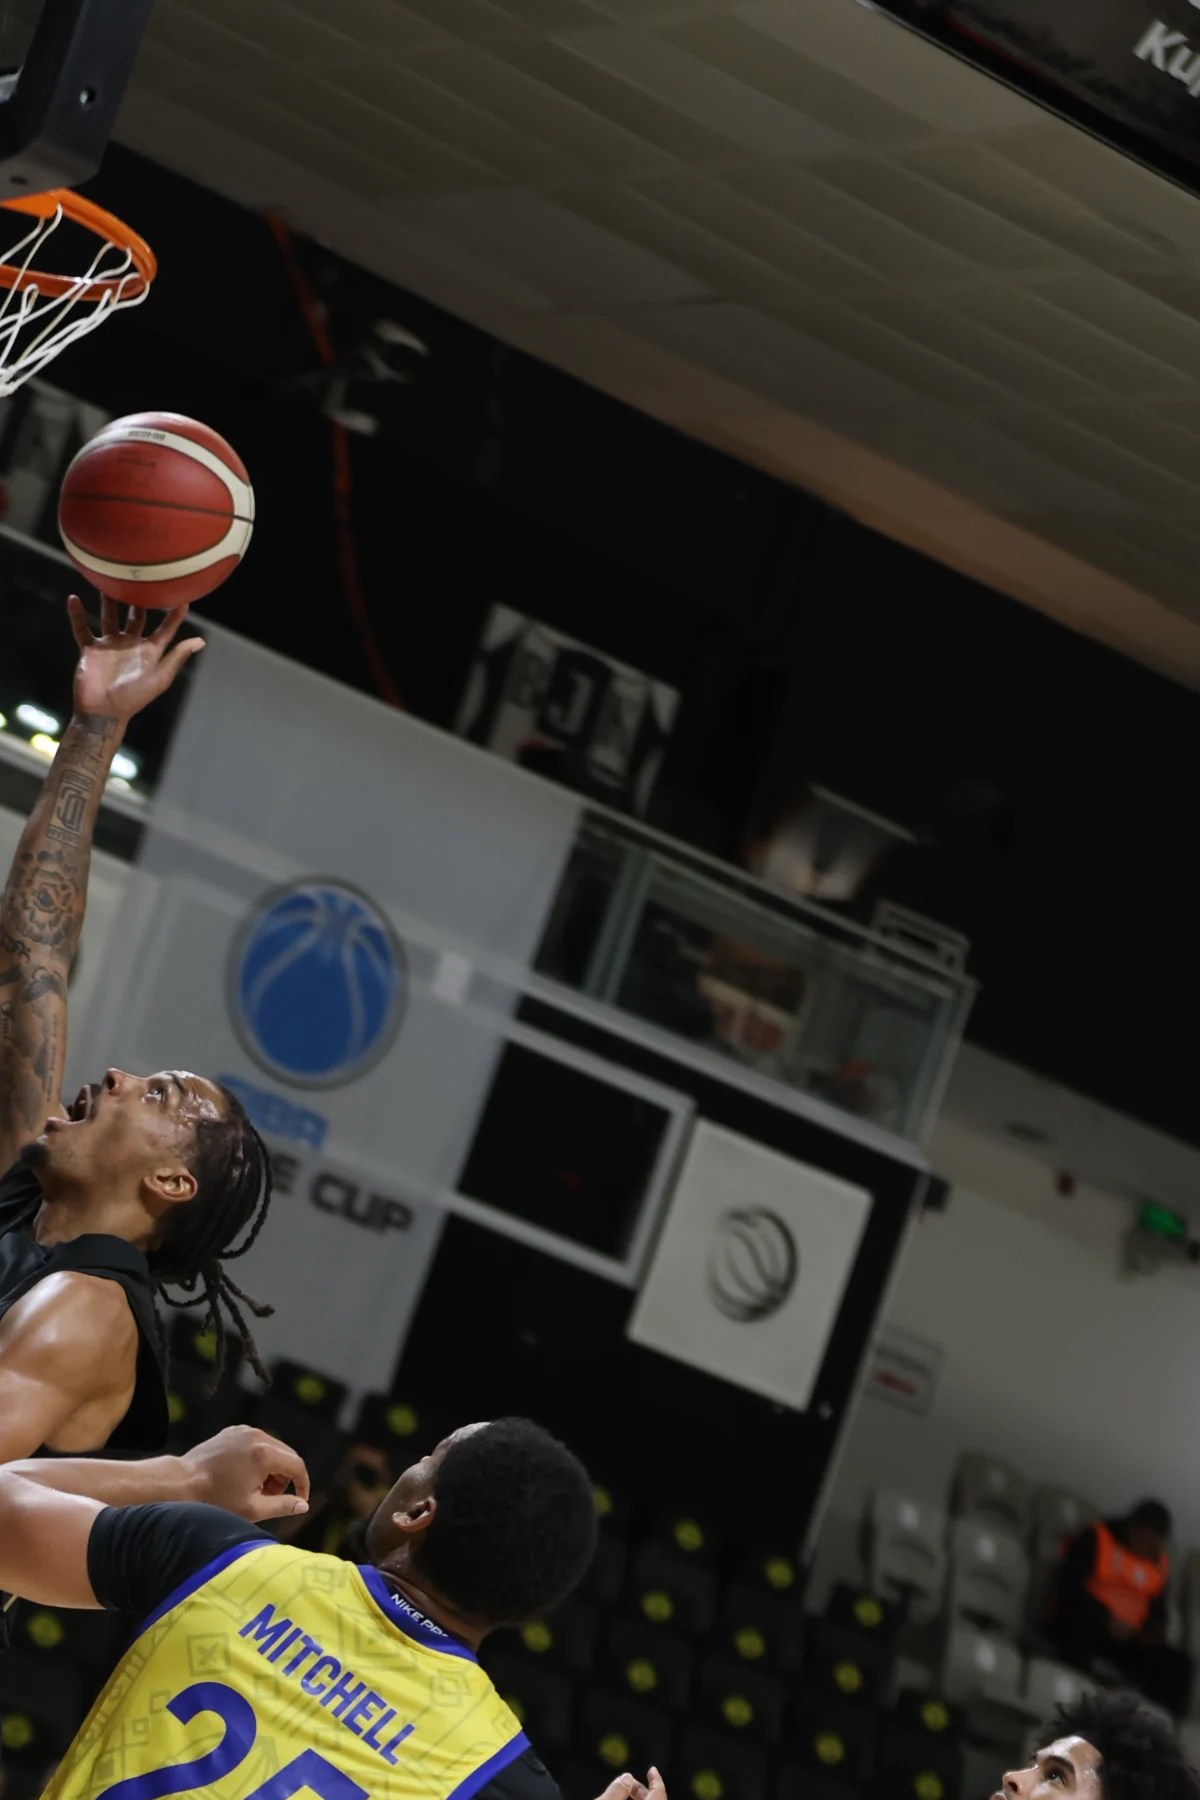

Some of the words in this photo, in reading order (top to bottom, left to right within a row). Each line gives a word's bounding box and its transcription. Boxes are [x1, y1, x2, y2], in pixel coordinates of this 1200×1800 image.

[309, 1171, 414, 1235] CUP
[391, 1593, 424, 1622] NIKE
[239, 1603, 416, 1765] MITCHELL
